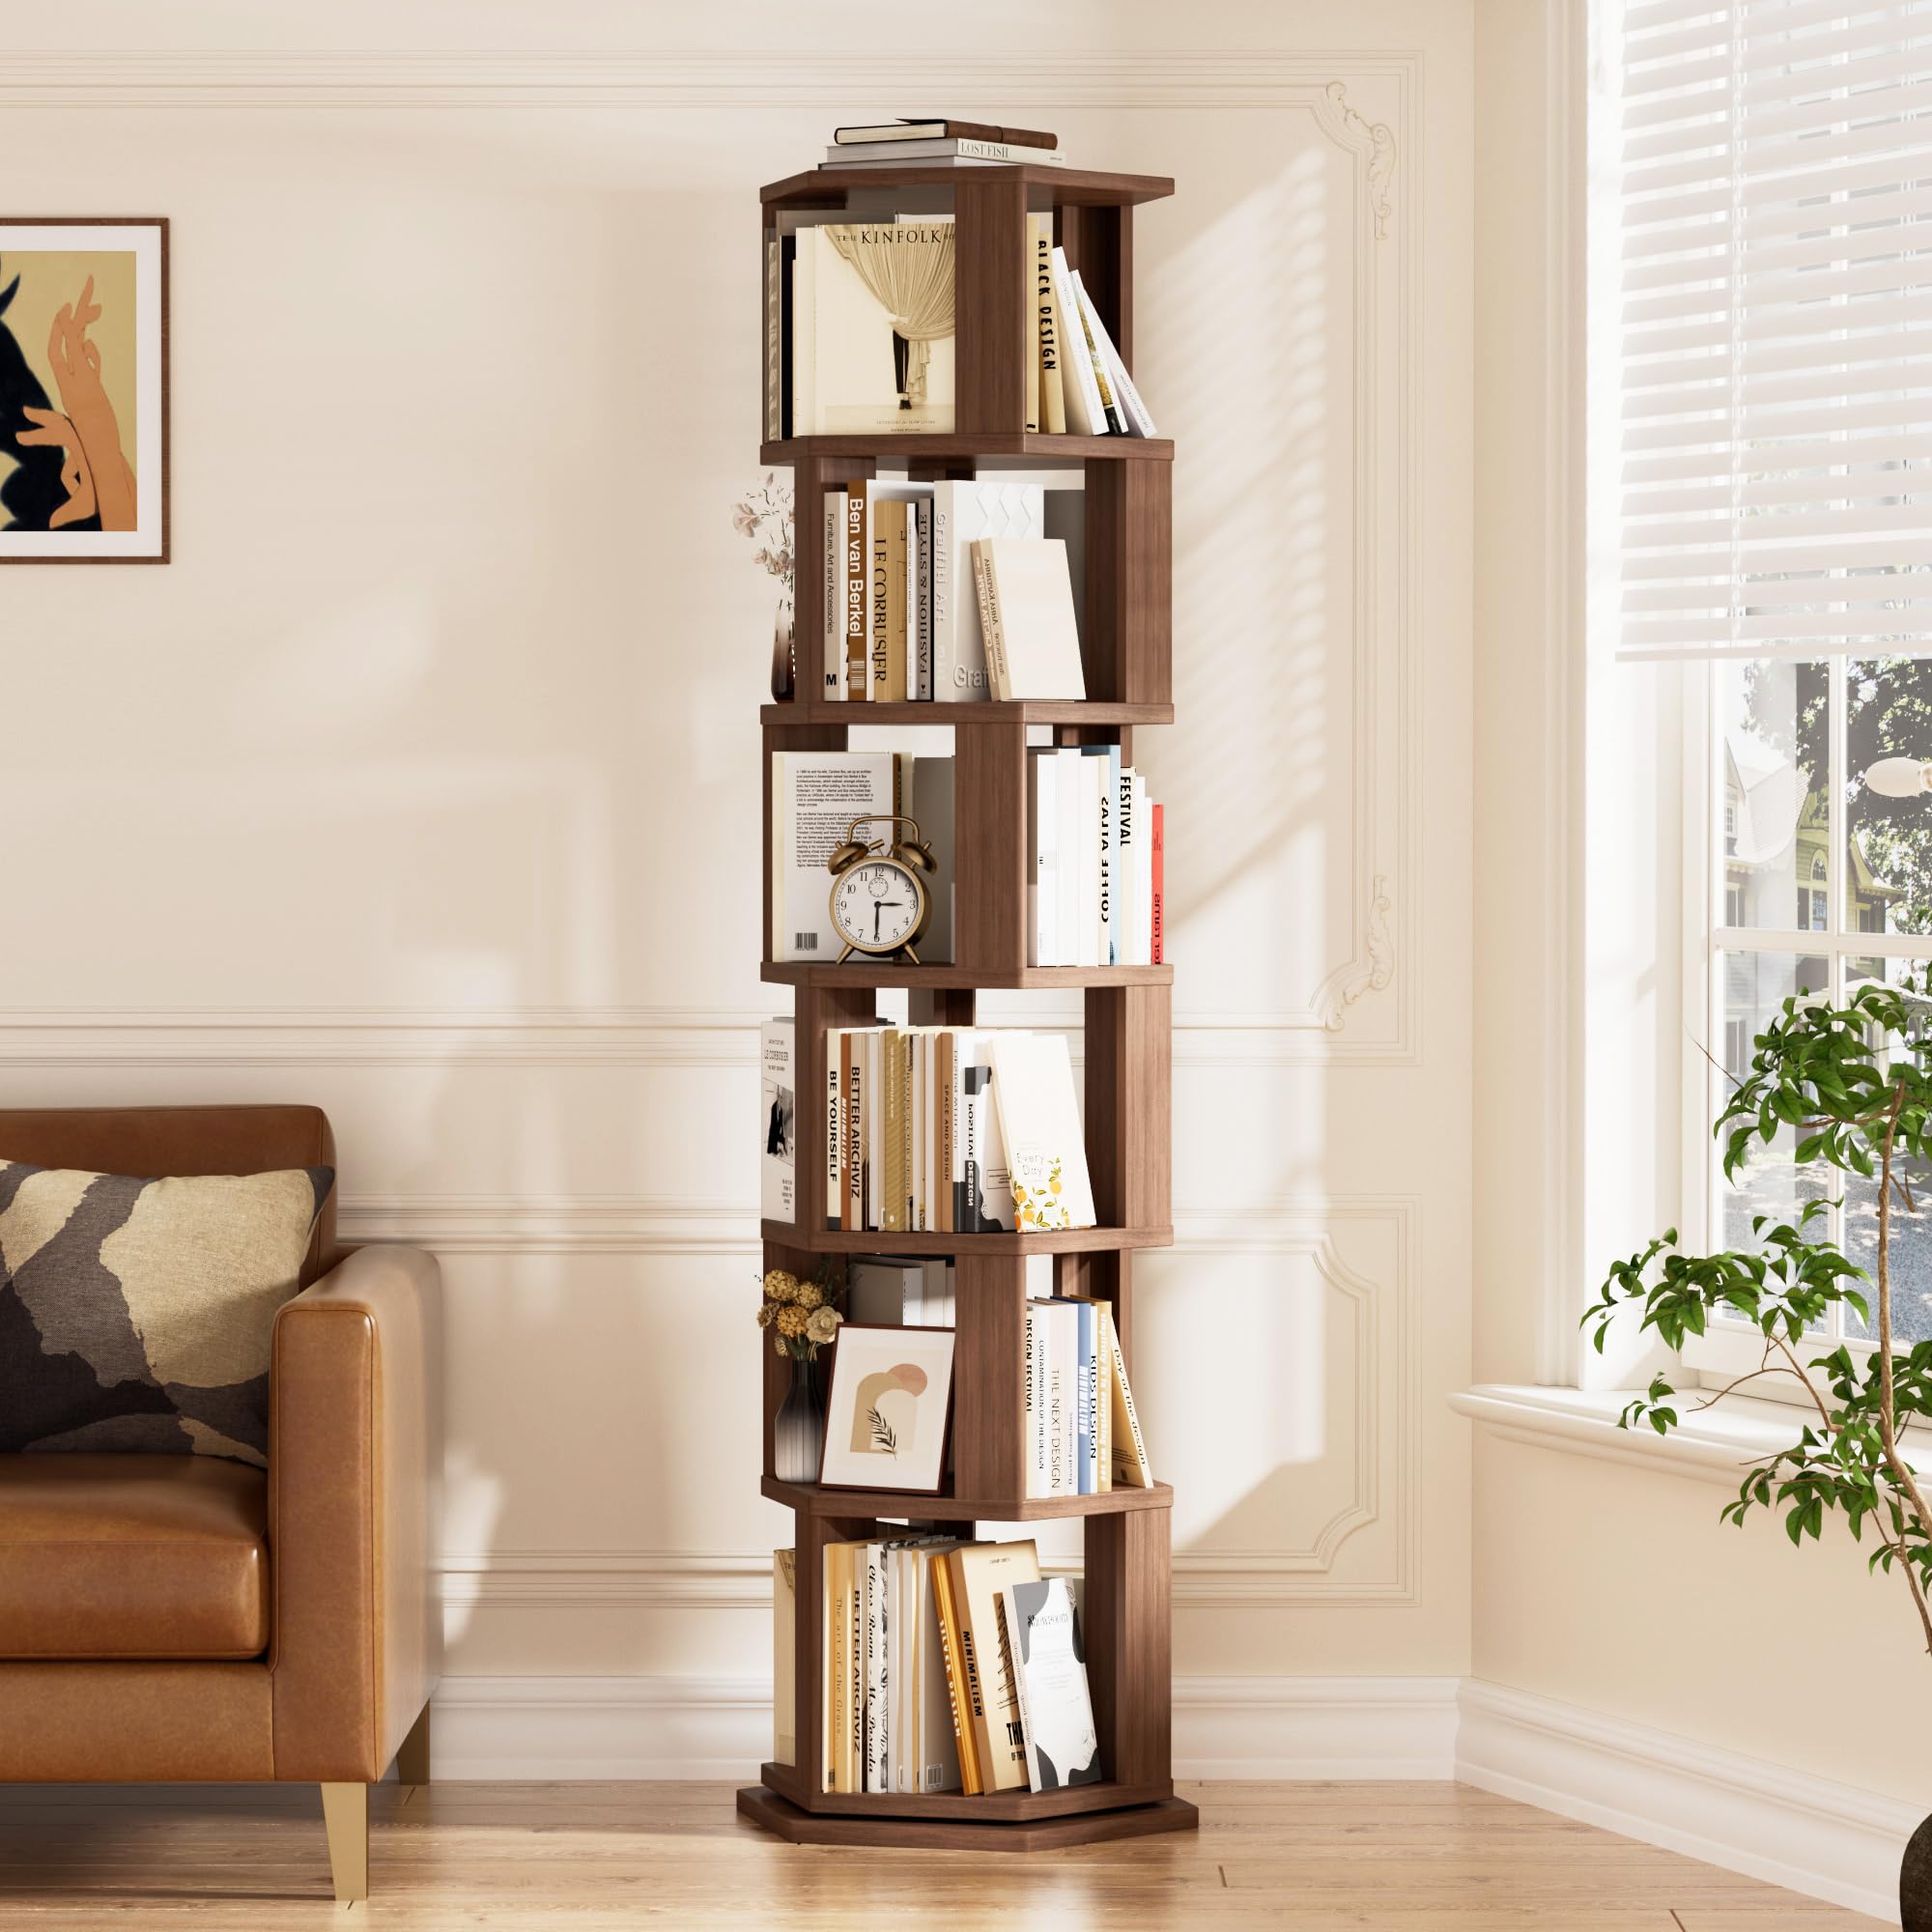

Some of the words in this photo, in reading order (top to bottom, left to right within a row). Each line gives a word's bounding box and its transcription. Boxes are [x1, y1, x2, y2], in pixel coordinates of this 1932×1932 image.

[961, 141, 985, 156] LOST
[987, 144, 1009, 158] FISH
[861, 230, 941, 244] KINFOLK
[1039, 306, 1056, 370] DESIGN
[850, 498, 864, 533] Ben
[850, 540, 861, 573] van
[936, 513, 947, 584] Graffiti
[920, 575, 927, 588] &
[850, 580, 864, 637] Berkel
[826, 674, 837, 686] M
[1120, 777, 1131, 847] FESTIVAL
[860, 871, 867, 881] 11
[875, 867, 884, 877] 12
[846, 884, 856, 894] 10
[905, 883, 911, 893] 2
[840, 900, 847, 910] 9
[909, 900, 916, 909] 3
[844, 918, 851, 926] 8
[903, 917, 909, 925] 4
[858, 928, 864, 938] 7
[893, 928, 899, 938] 5
[830, 1070, 838, 1091] BE
[851, 1066, 860, 1124] BETTER
[851, 1128, 860, 1199] ARCHVIZ
[1051, 1370, 1060, 1393] THE
[1051, 1400, 1061, 1433] NEXT
[1114, 1350, 1123, 1374] Day
[1125, 1396, 1134, 1416] the
[1131, 1422, 1146, 1464] design
[1051, 1438, 1061, 1489] DESIGN
[836, 1652, 842, 1666] of
[962, 1631, 982, 1717] MINIMALISM
[949, 1681, 961, 1737] DESIGN
